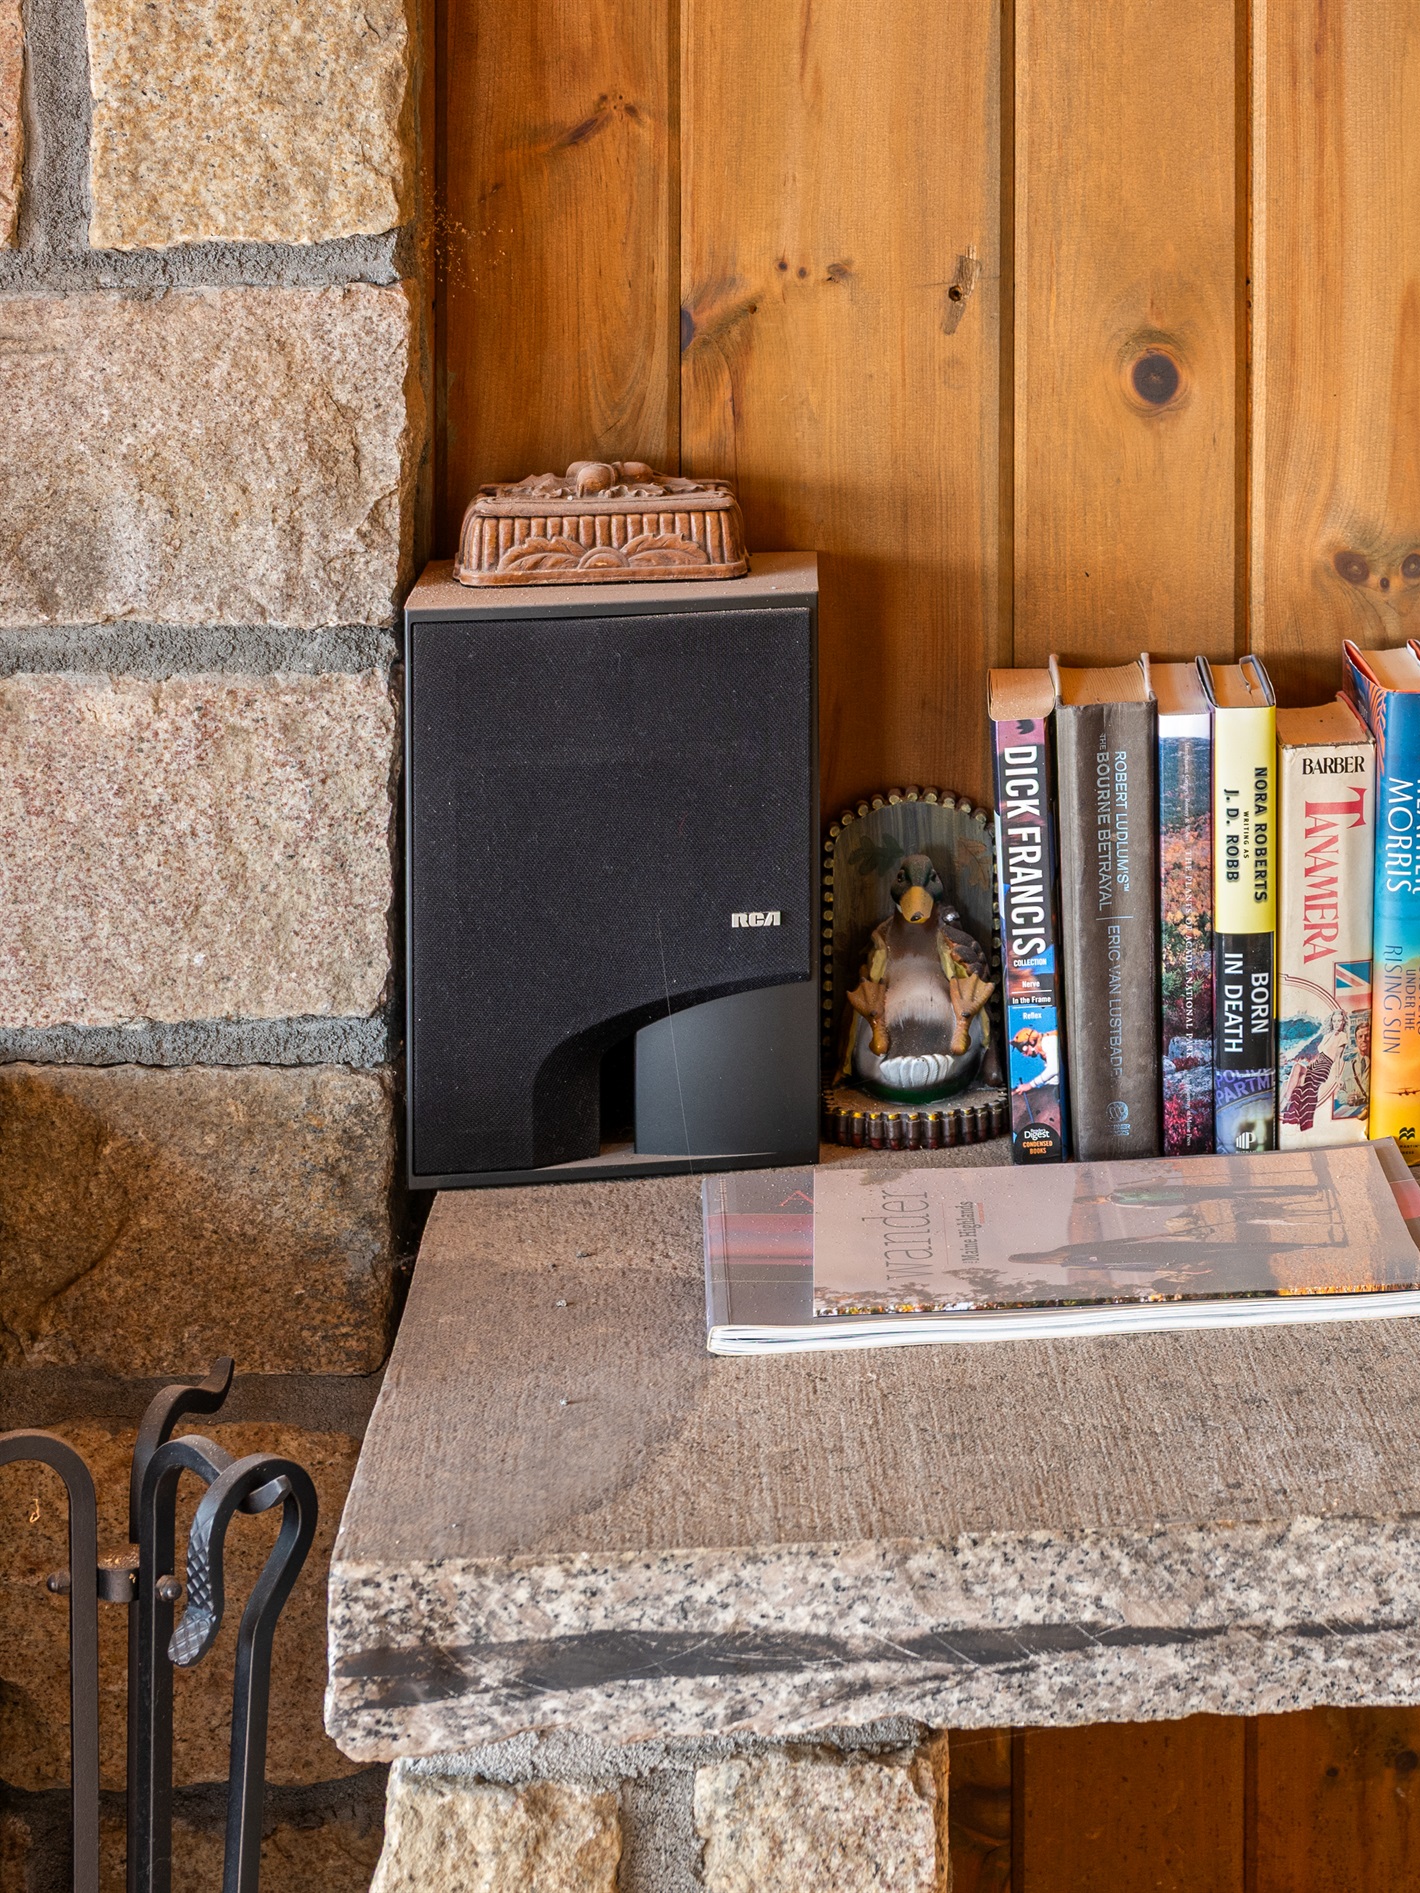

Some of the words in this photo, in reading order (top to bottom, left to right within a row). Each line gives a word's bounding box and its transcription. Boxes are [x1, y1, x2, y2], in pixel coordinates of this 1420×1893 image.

[1099, 733, 1107, 750] THE
[1003, 745, 1041, 820] DICK
[1114, 750, 1128, 810] ROBERT
[1302, 756, 1366, 776] BARBER
[1096, 752, 1111, 826] BOURNE
[1224, 789, 1240, 801] J.
[1254, 766, 1268, 815] NORA
[1226, 808, 1240, 825] D.
[1384, 776, 1414, 893] MORRIS
[1097, 830, 1113, 912] BETRAYAL
[1184, 850, 1192, 872] THE
[1226, 834, 1240, 882] ROBB
[1243, 848, 1250, 859] AS
[1254, 822, 1268, 902] ROBERTS
[1006, 826, 1047, 957] FRANCIS
[1302, 786, 1368, 965] TANAMERA
[1184, 876, 1193, 914] PLANTS
[731, 911, 782, 928] RCA
[1185, 918, 1193, 931] OF
[1107, 925, 1121, 962] ERIC
[1184, 934, 1193, 974] ACADIA
[1013, 957, 1048, 968] COLLECTION
[1108, 964, 1122, 996] VAN
[1224, 953, 1244, 975] IN
[1384, 944, 1404, 1011] RISING
[1012, 996, 1020, 1004] In
[1020, 996, 1031, 1004] the
[1032, 994, 1052, 1004] Frame
[1021, 979, 1040, 989] Nerve
[1404, 968, 1416, 1009] UNDER
[1022, 1011, 1042, 1020] Reflex
[1185, 976, 1194, 1030] NATIONAL
[1224, 985, 1244, 1052] DEATH
[1250, 972, 1270, 1034] BORN
[1404, 1011, 1416, 1031] THE
[1108, 998, 1123, 1080] LUSTBADE
[1186, 1032, 1194, 1058] PARK
[1382, 1018, 1402, 1054] SUN
[1022, 1140, 1053, 1148] CONDENSED
[1024, 1130, 1050, 1140] Digest
[861, 1190, 934, 1281] wander
[954, 1201, 982, 1238] Highlands
[959, 1239, 980, 1262] Maine
